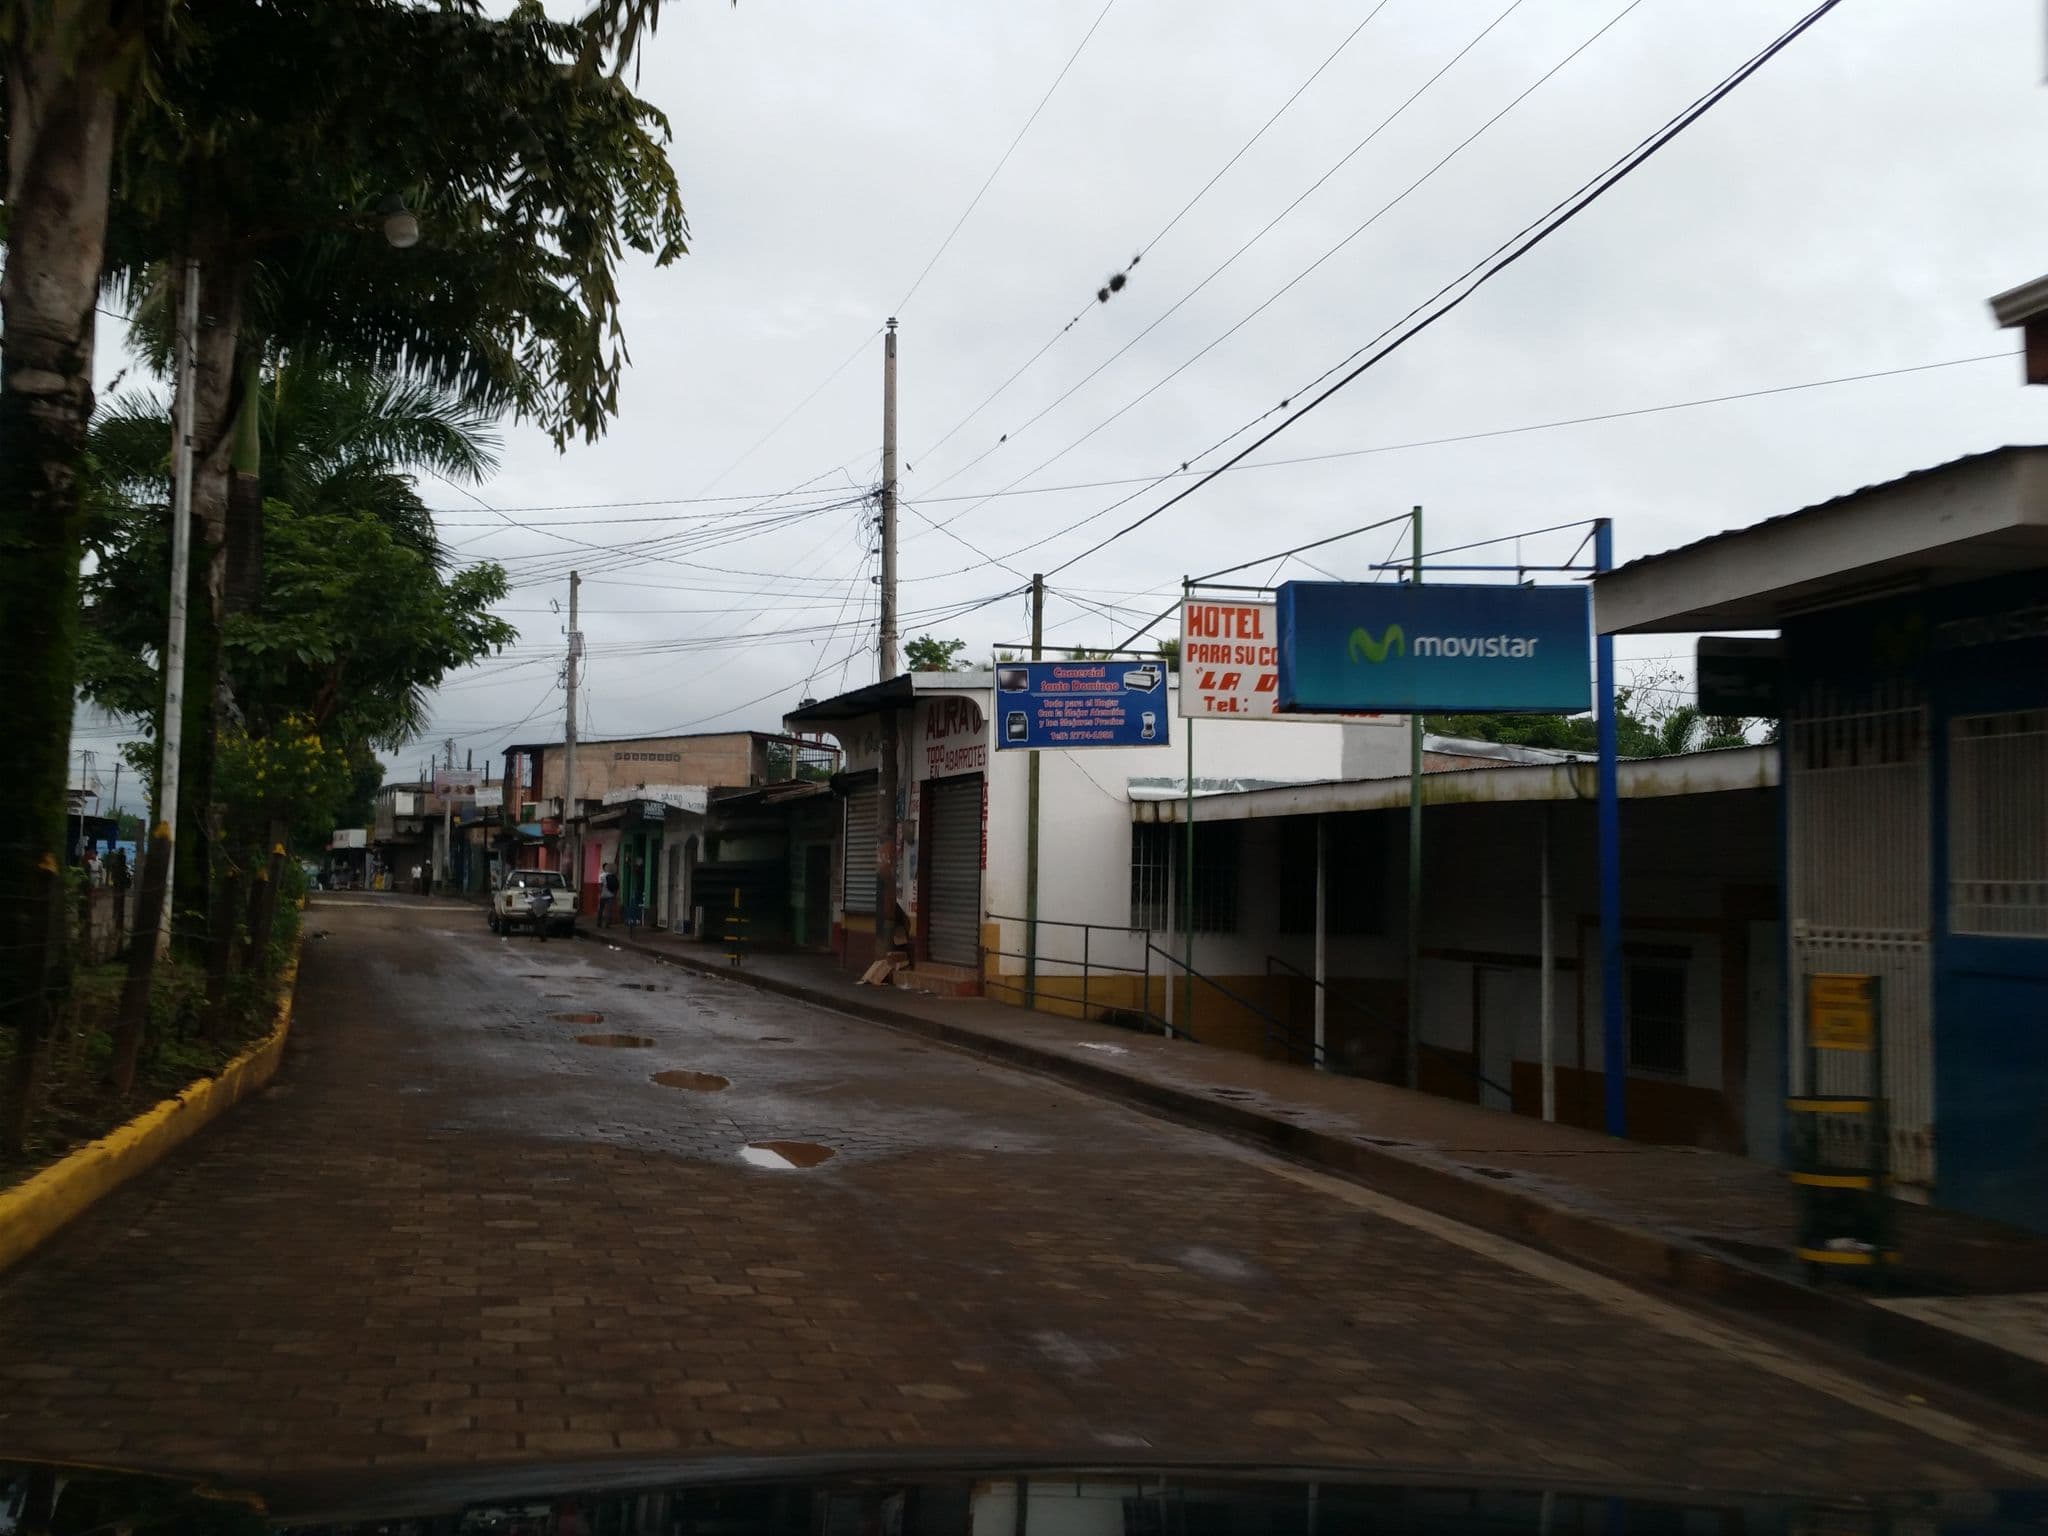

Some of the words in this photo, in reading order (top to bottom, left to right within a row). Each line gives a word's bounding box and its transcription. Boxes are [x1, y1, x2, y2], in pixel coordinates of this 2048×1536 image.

[1187, 605, 1265, 640] HOTEL
[1187, 643, 1231, 664] PARA
[1235, 645, 1255, 666] SU
[1414, 634, 1538, 658] movistar
[1053, 666, 1106, 679] Comercial
[1040, 680, 1071, 692] Santo
[1071, 680, 1120, 692] Domingo
[926, 745, 945, 765] TODO
[945, 743, 986, 773] ABARROTES
